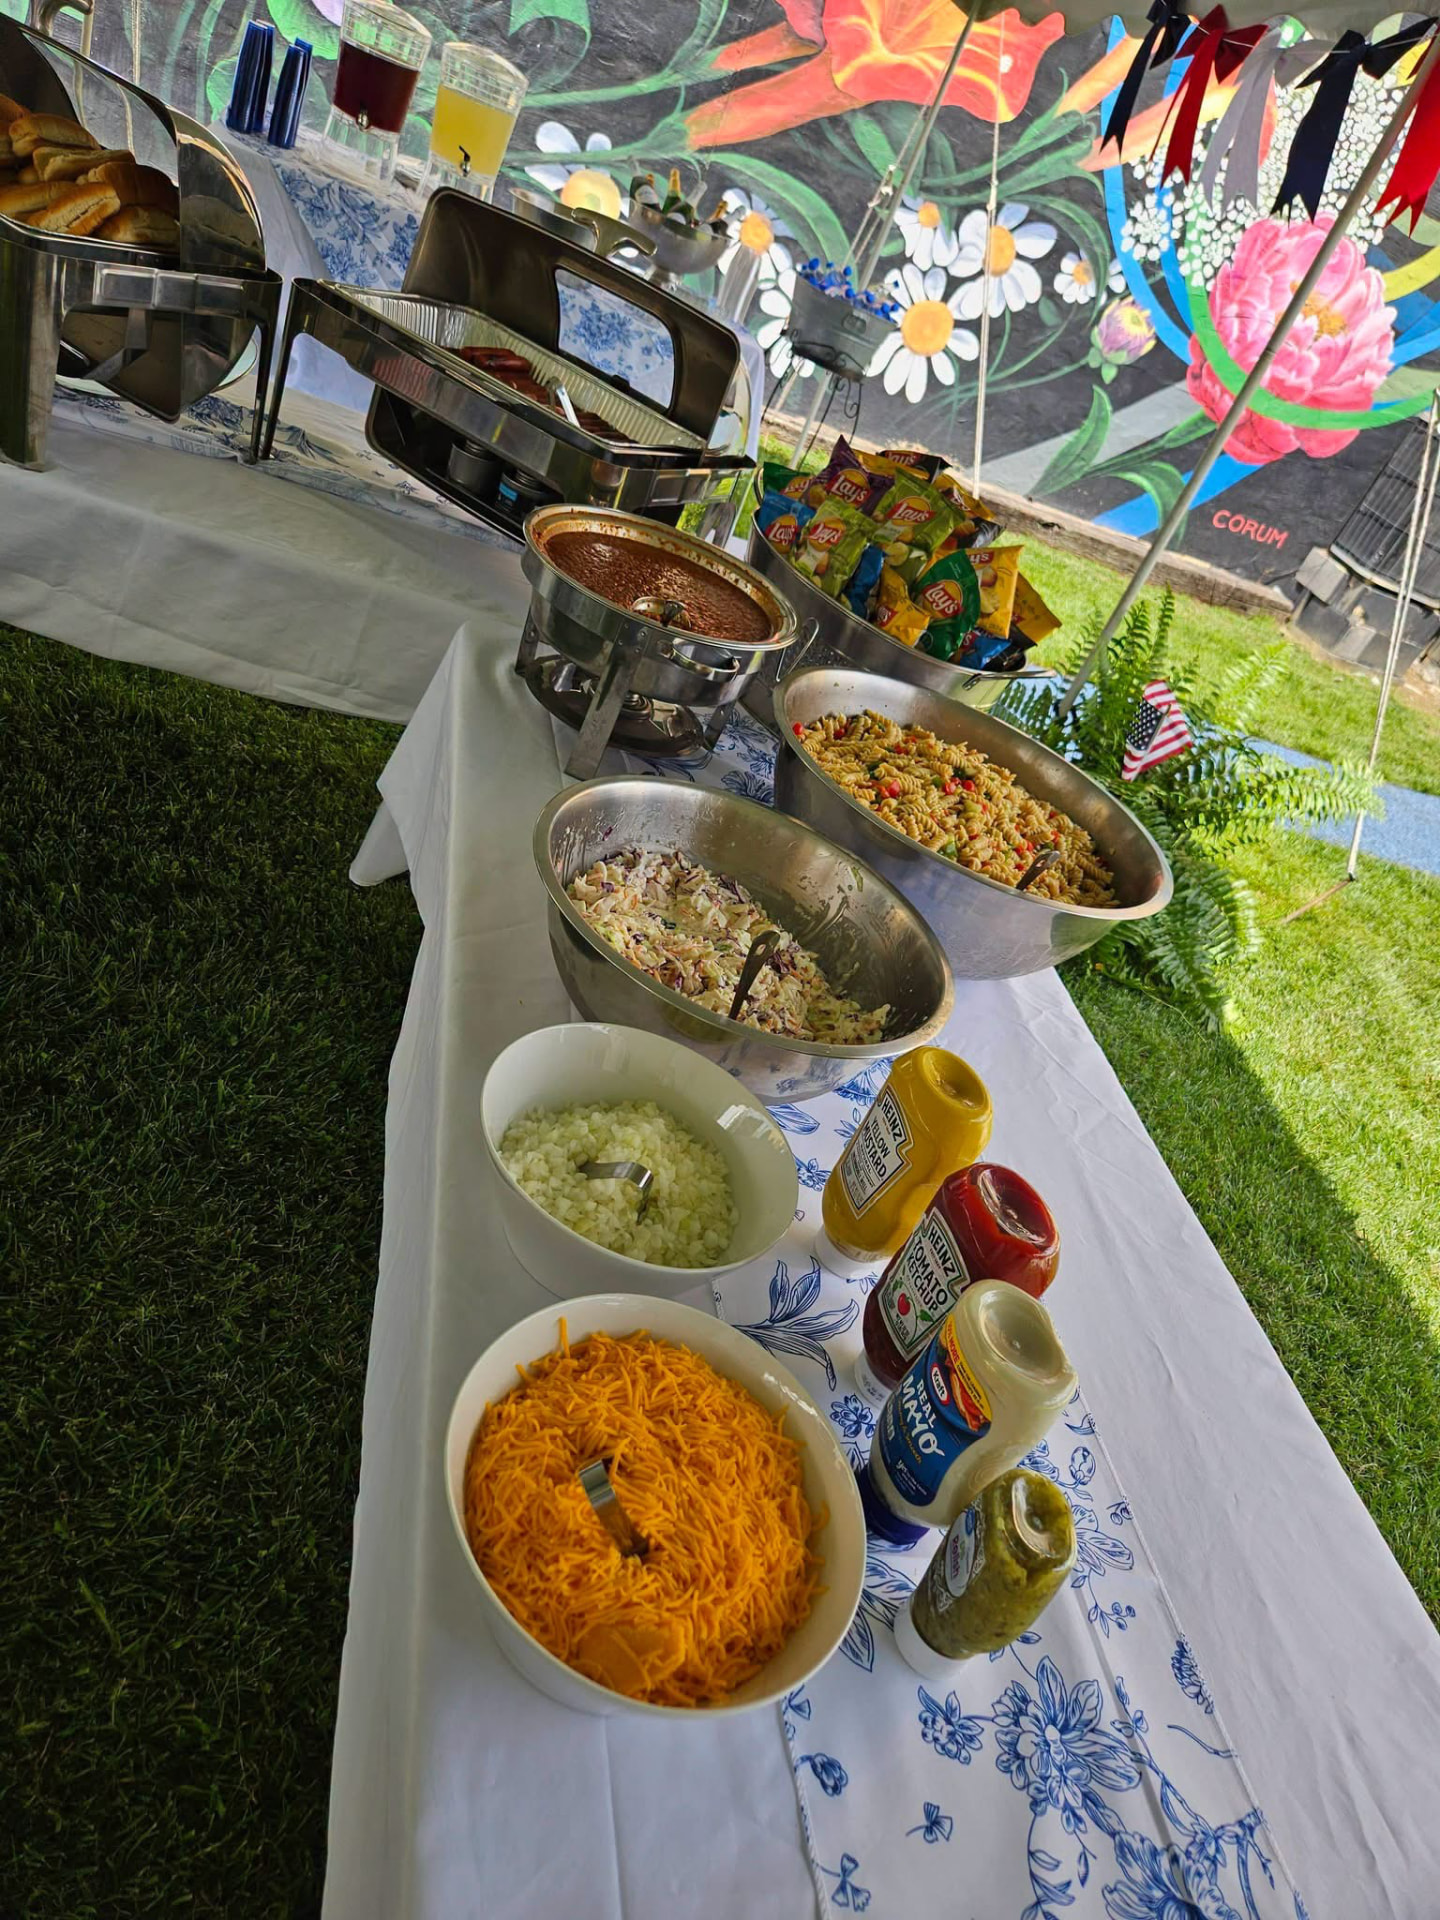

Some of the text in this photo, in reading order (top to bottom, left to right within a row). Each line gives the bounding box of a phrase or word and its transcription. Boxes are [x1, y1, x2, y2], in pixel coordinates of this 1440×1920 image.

[830, 474, 868, 504] Lay's
[811, 522, 842, 543] Lay's
[893, 502, 930, 522] Lay's
[1212, 509, 1290, 549] CORUM
[768, 522, 796, 546] Lay's
[969, 553, 990, 565] y's
[925, 584, 958, 614] Lay's
[870, 1115, 892, 1159] YELLOW
[881, 1097, 903, 1142] HEINZ
[863, 1120, 887, 1178] MUSTARD
[913, 1236, 948, 1306] TOMATO
[928, 1226, 956, 1277] HEINZ
[907, 1252, 939, 1312] KETCHUP
[917, 1379, 937, 1428] REAL
[933, 1370, 946, 1398] Kraft
[902, 1375, 946, 1456] MAYO
